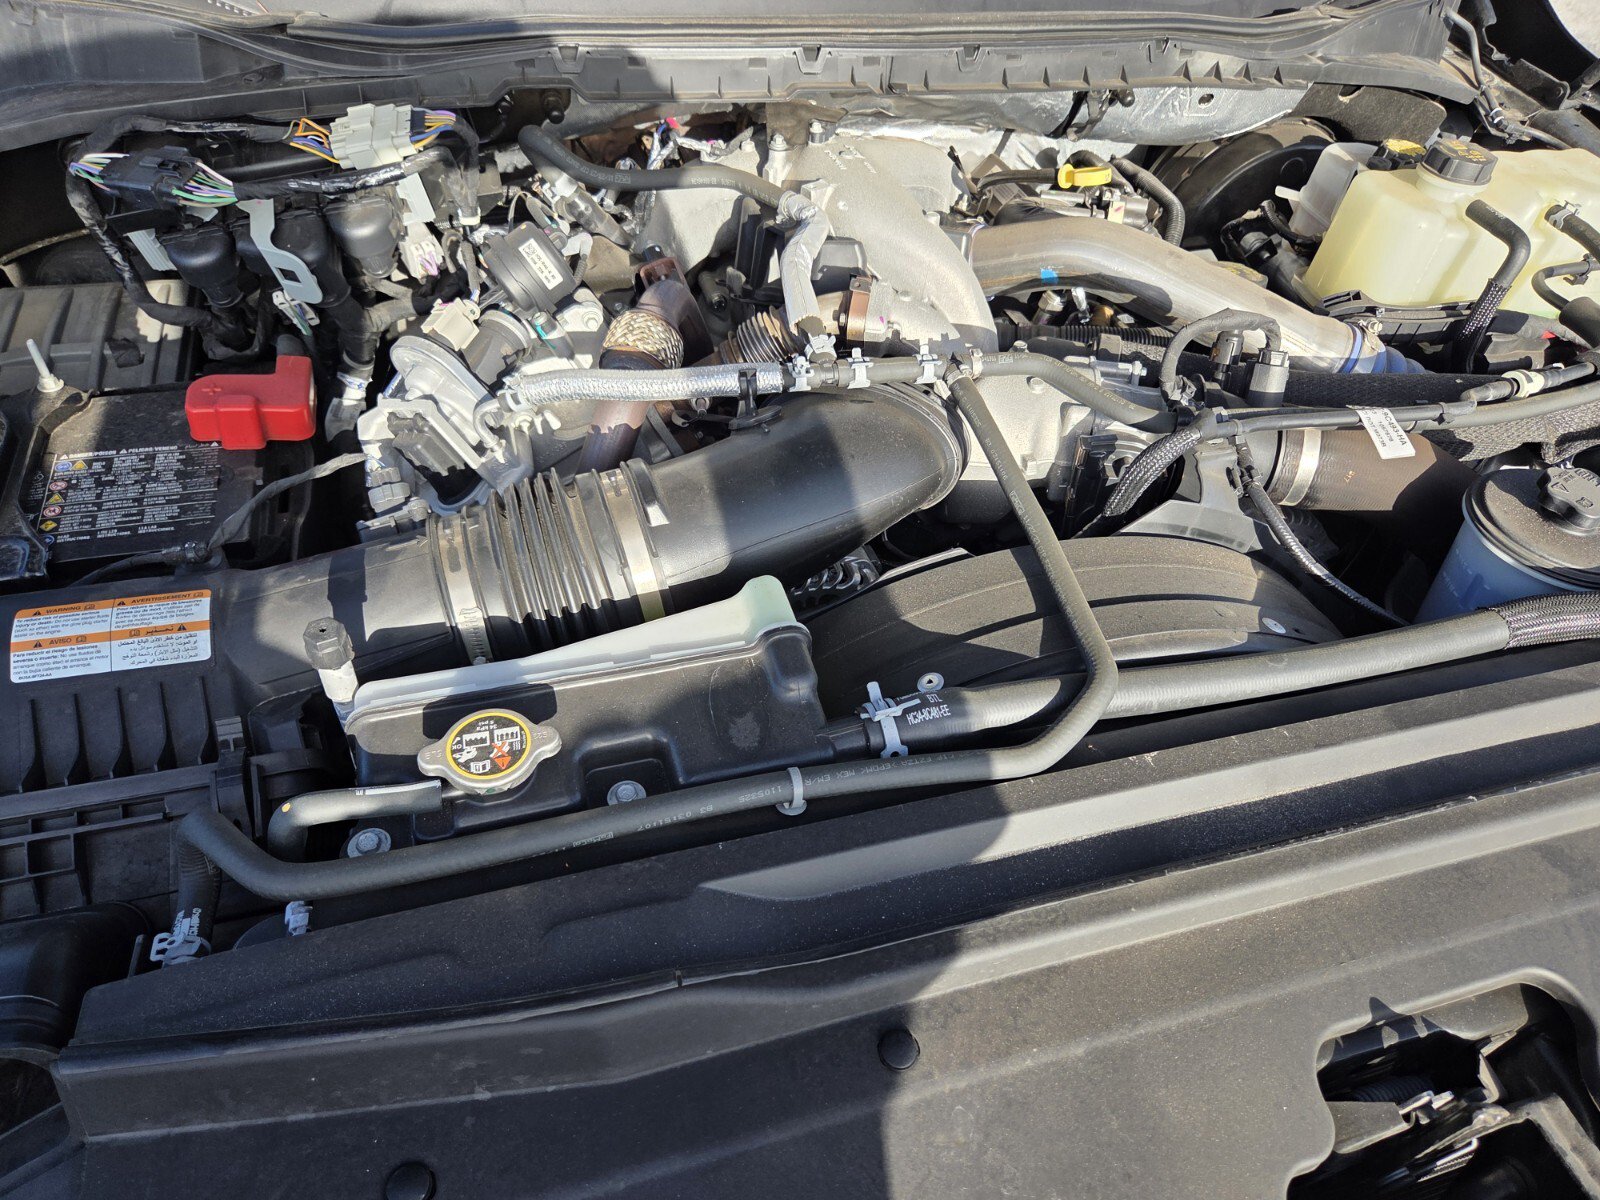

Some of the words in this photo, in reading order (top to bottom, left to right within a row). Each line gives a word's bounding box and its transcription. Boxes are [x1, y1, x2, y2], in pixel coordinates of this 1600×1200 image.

[46, 606, 81, 614] WARNING
[926, 693, 943, 703] BTL
[836, 769, 856, 779] MEX
[739, 785, 782, 803] 1105325
